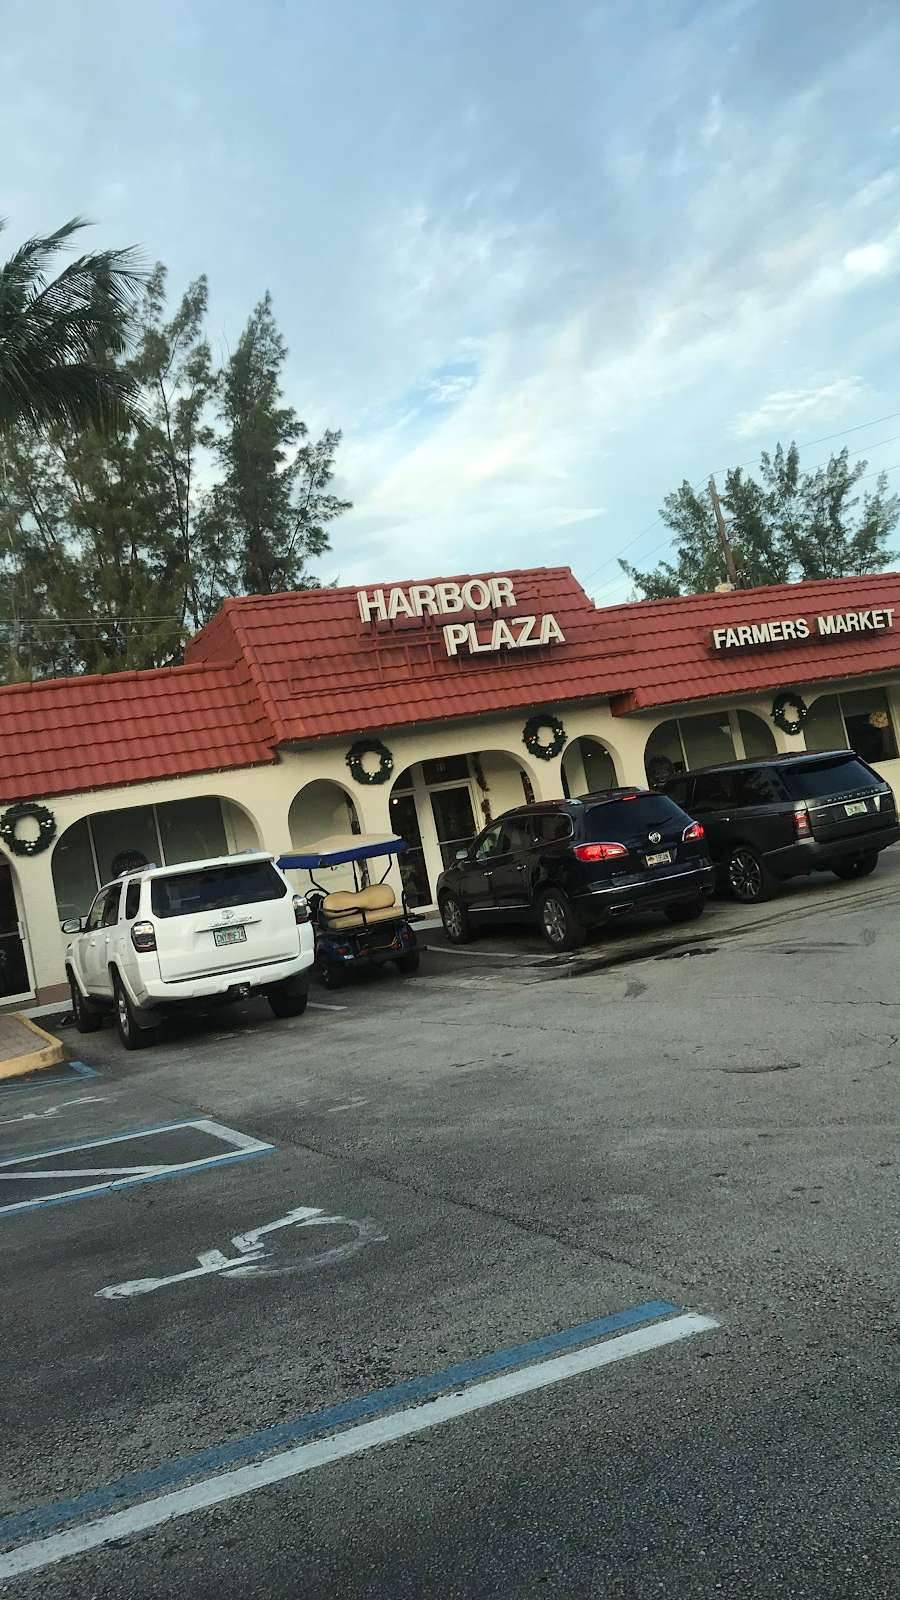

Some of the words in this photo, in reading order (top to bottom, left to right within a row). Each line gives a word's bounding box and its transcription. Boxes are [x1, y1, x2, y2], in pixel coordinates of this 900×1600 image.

[356, 577, 517, 624] HARBOR
[442, 613, 566, 657] PLAZA
[712, 618, 810, 649] FARMERS
[816, 608, 895, 636] MARKET
